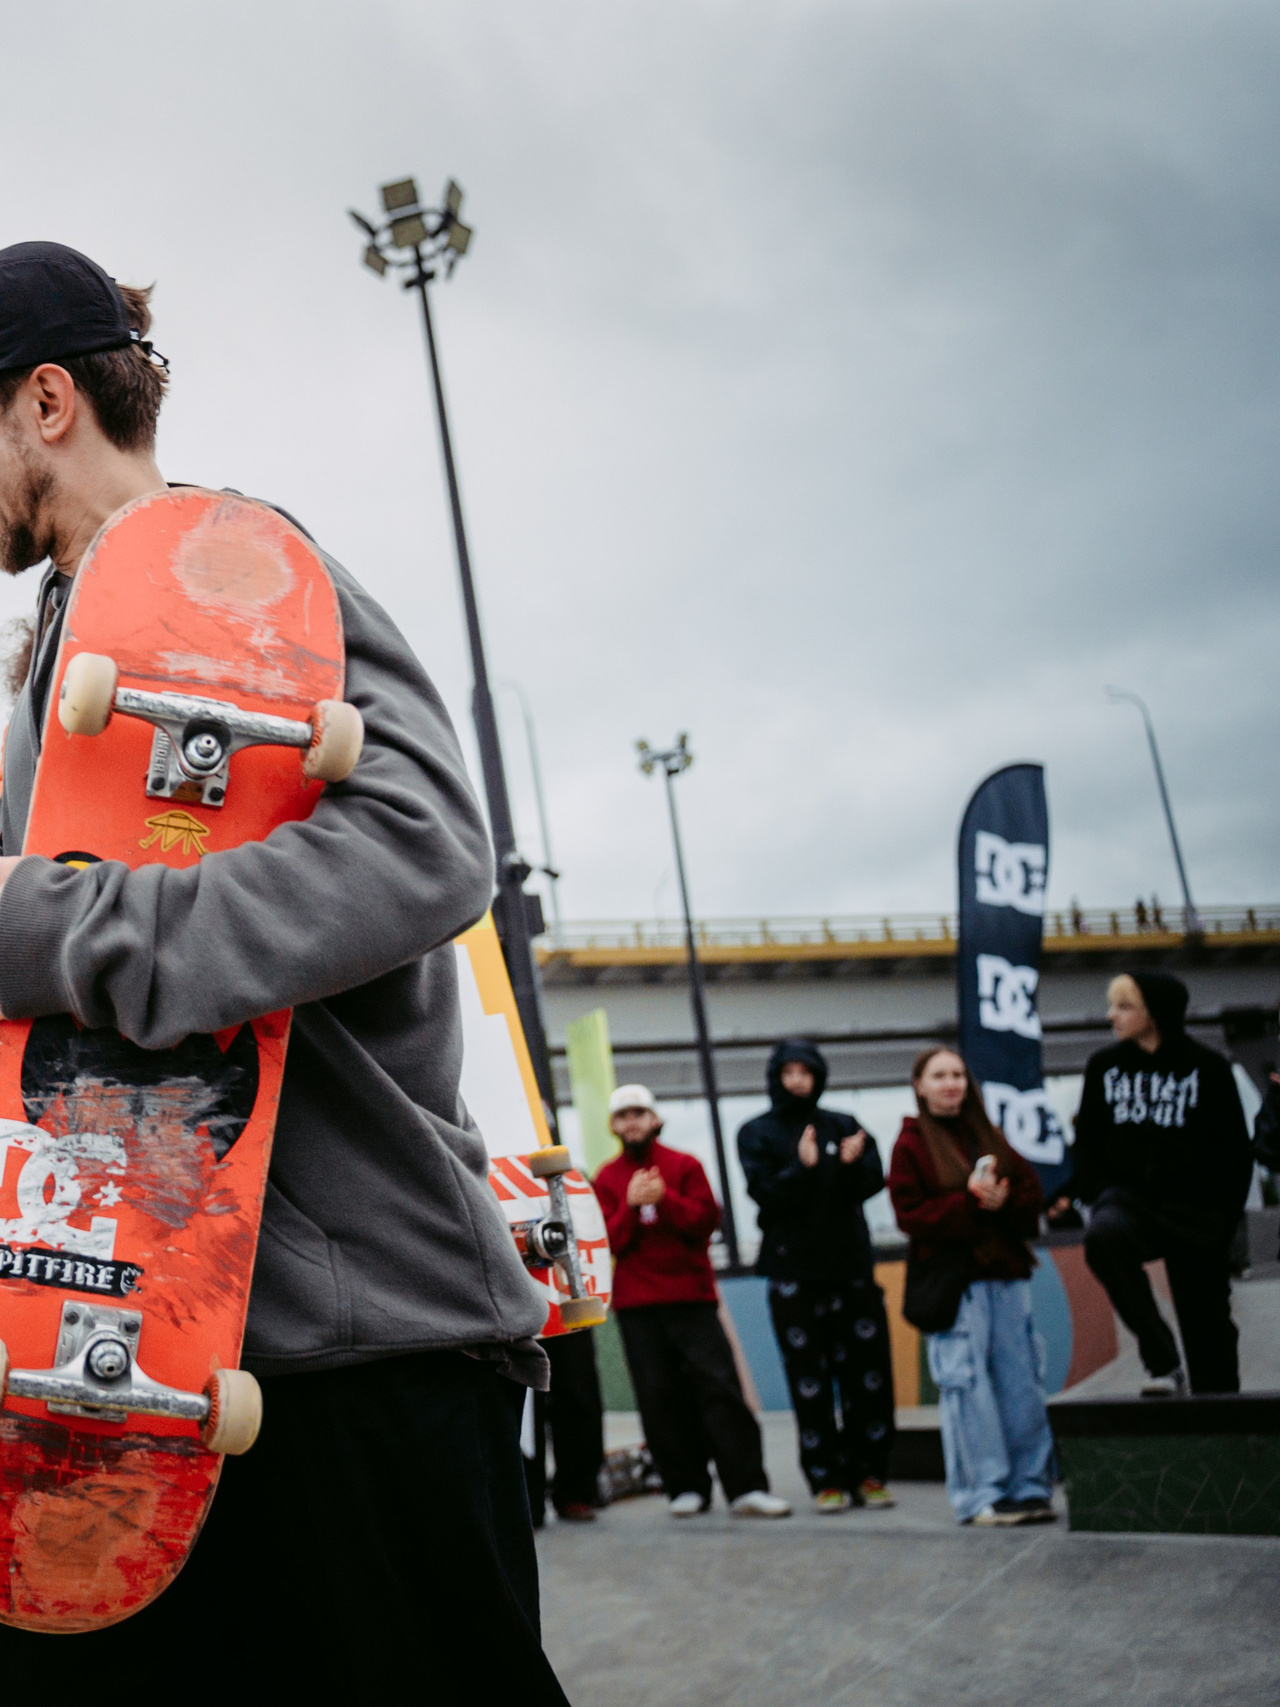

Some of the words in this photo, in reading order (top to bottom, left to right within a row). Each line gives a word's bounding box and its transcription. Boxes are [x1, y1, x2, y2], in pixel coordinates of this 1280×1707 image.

[975, 829, 1046, 917] DC
[976, 953, 1043, 1040] DC
[981, 1081, 1064, 1165] DC
